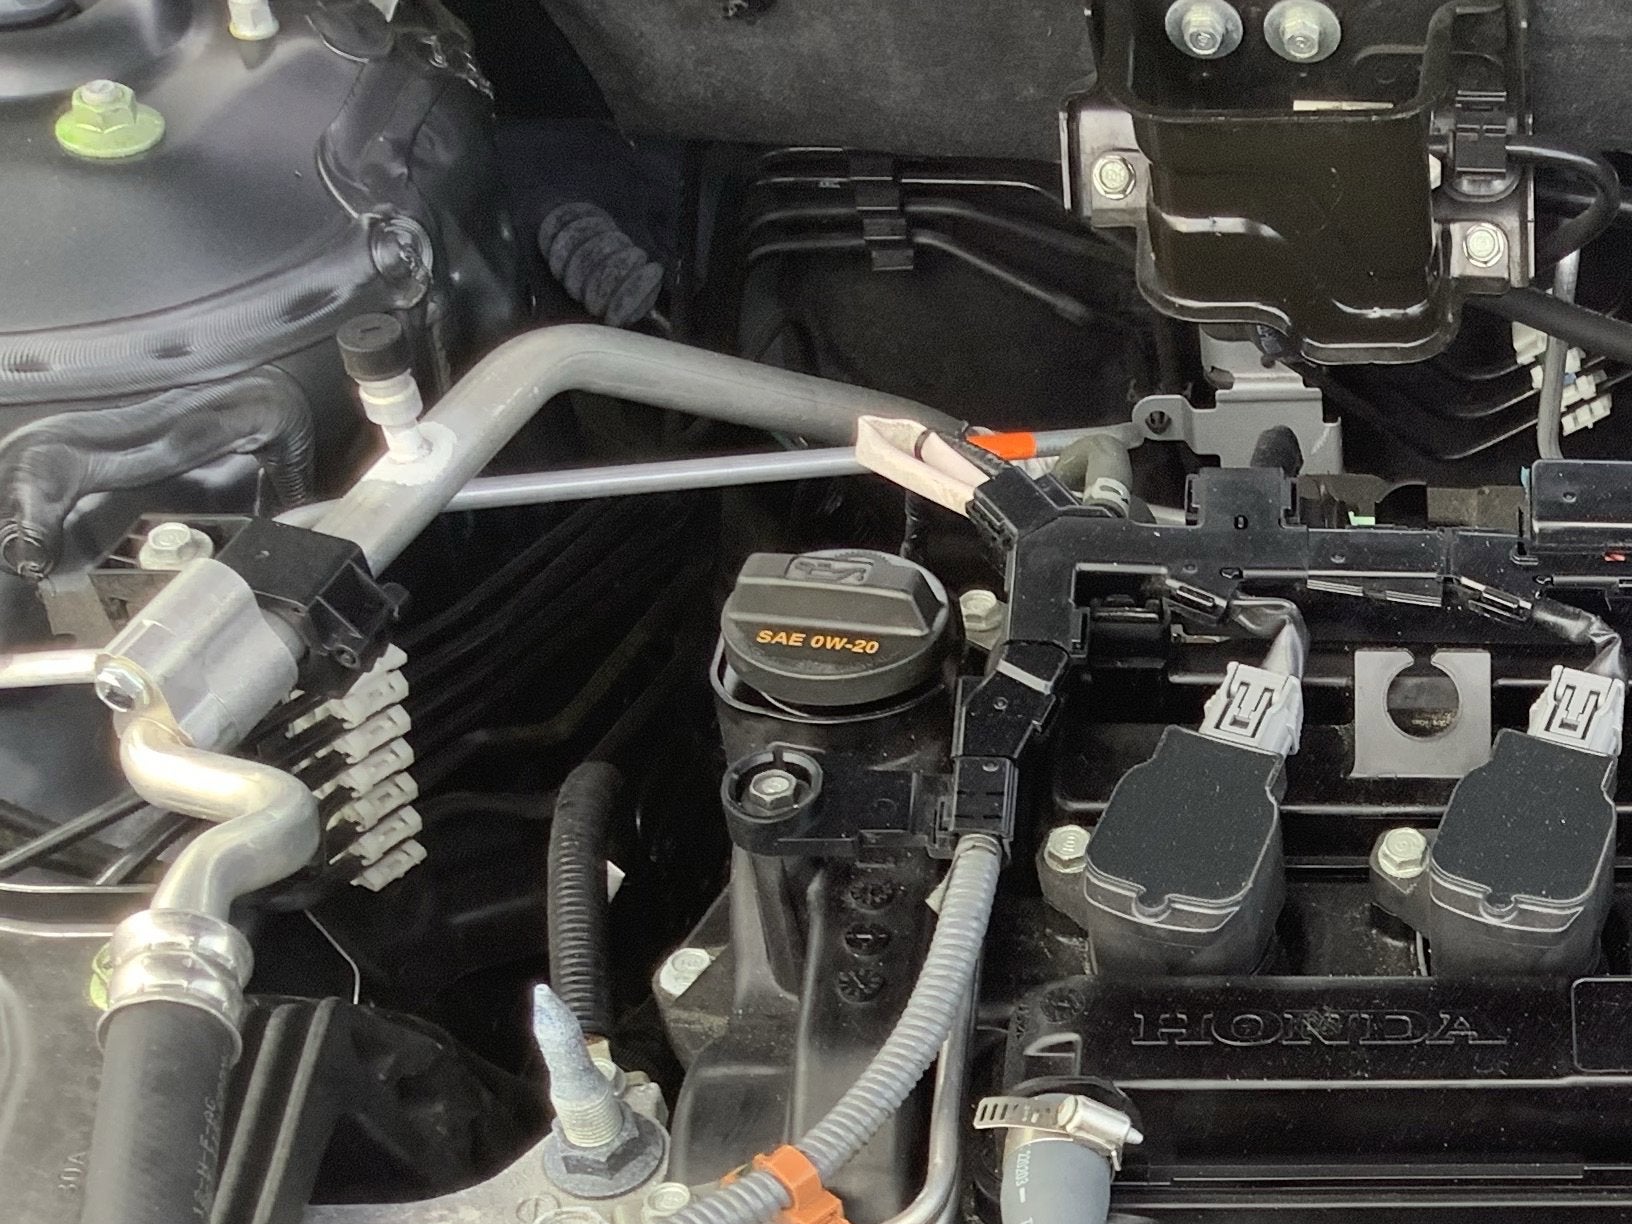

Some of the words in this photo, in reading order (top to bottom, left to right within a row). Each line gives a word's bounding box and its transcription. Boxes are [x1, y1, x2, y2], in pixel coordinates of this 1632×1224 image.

[755, 629, 807, 647] SAE
[810, 634, 880, 655] 0W-20
[1130, 1009, 1508, 1048] HONDA
